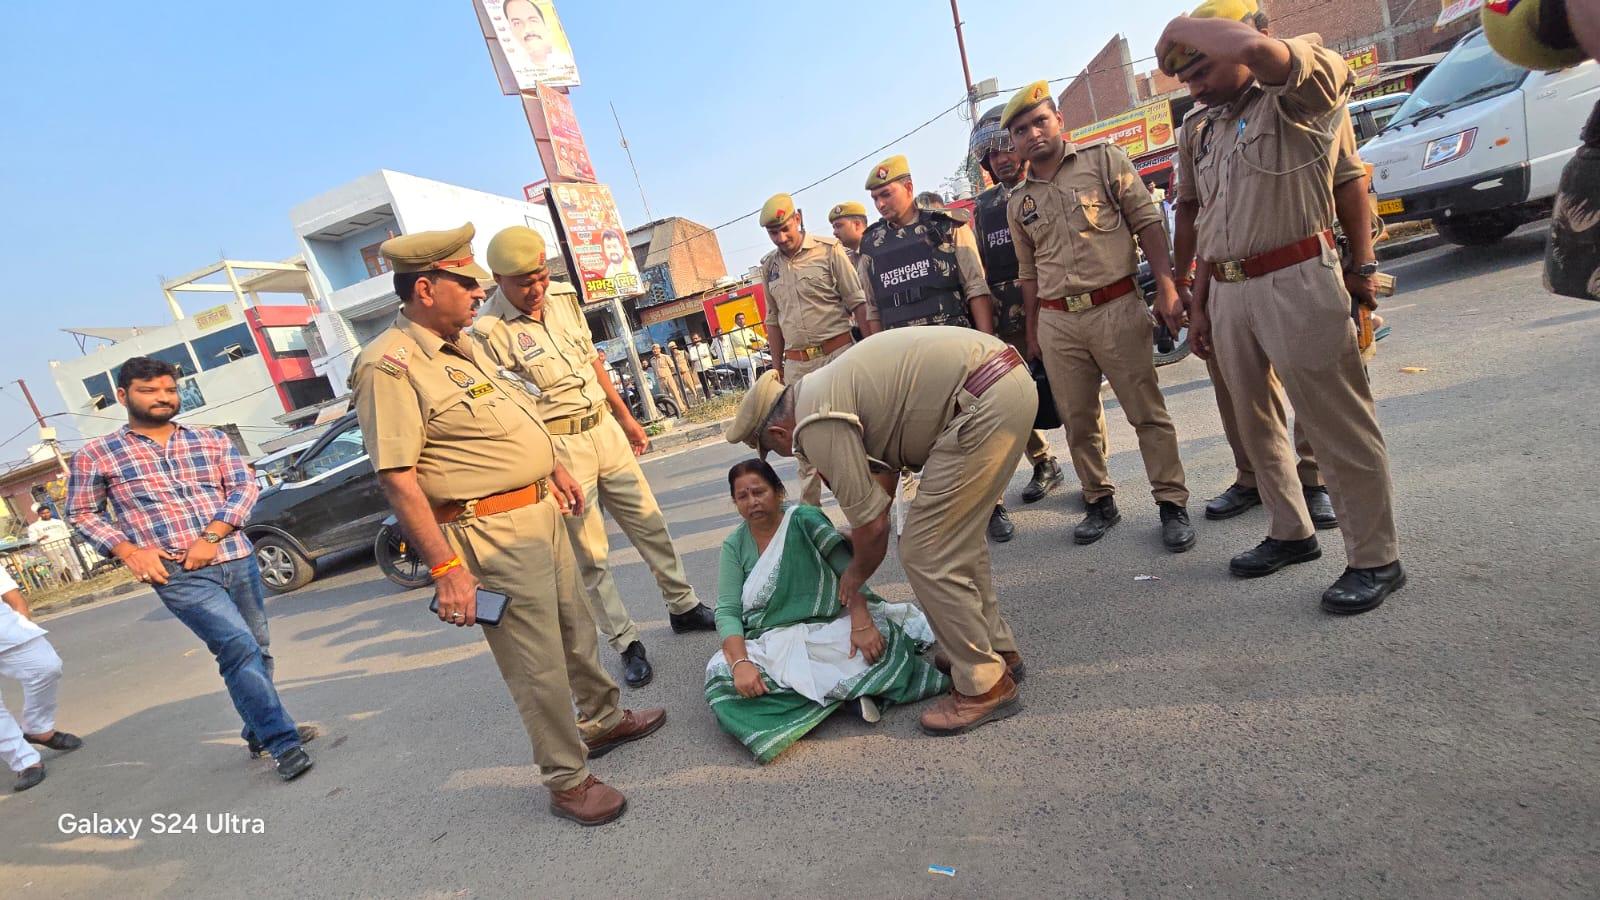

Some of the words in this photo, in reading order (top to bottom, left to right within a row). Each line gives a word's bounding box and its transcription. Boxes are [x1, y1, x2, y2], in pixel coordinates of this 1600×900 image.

[987, 227, 1010, 242] FATEH
[990, 236, 1011, 248] POL
[880, 258, 930, 282] FATEHGARH
[883, 267, 928, 288] POLICE
